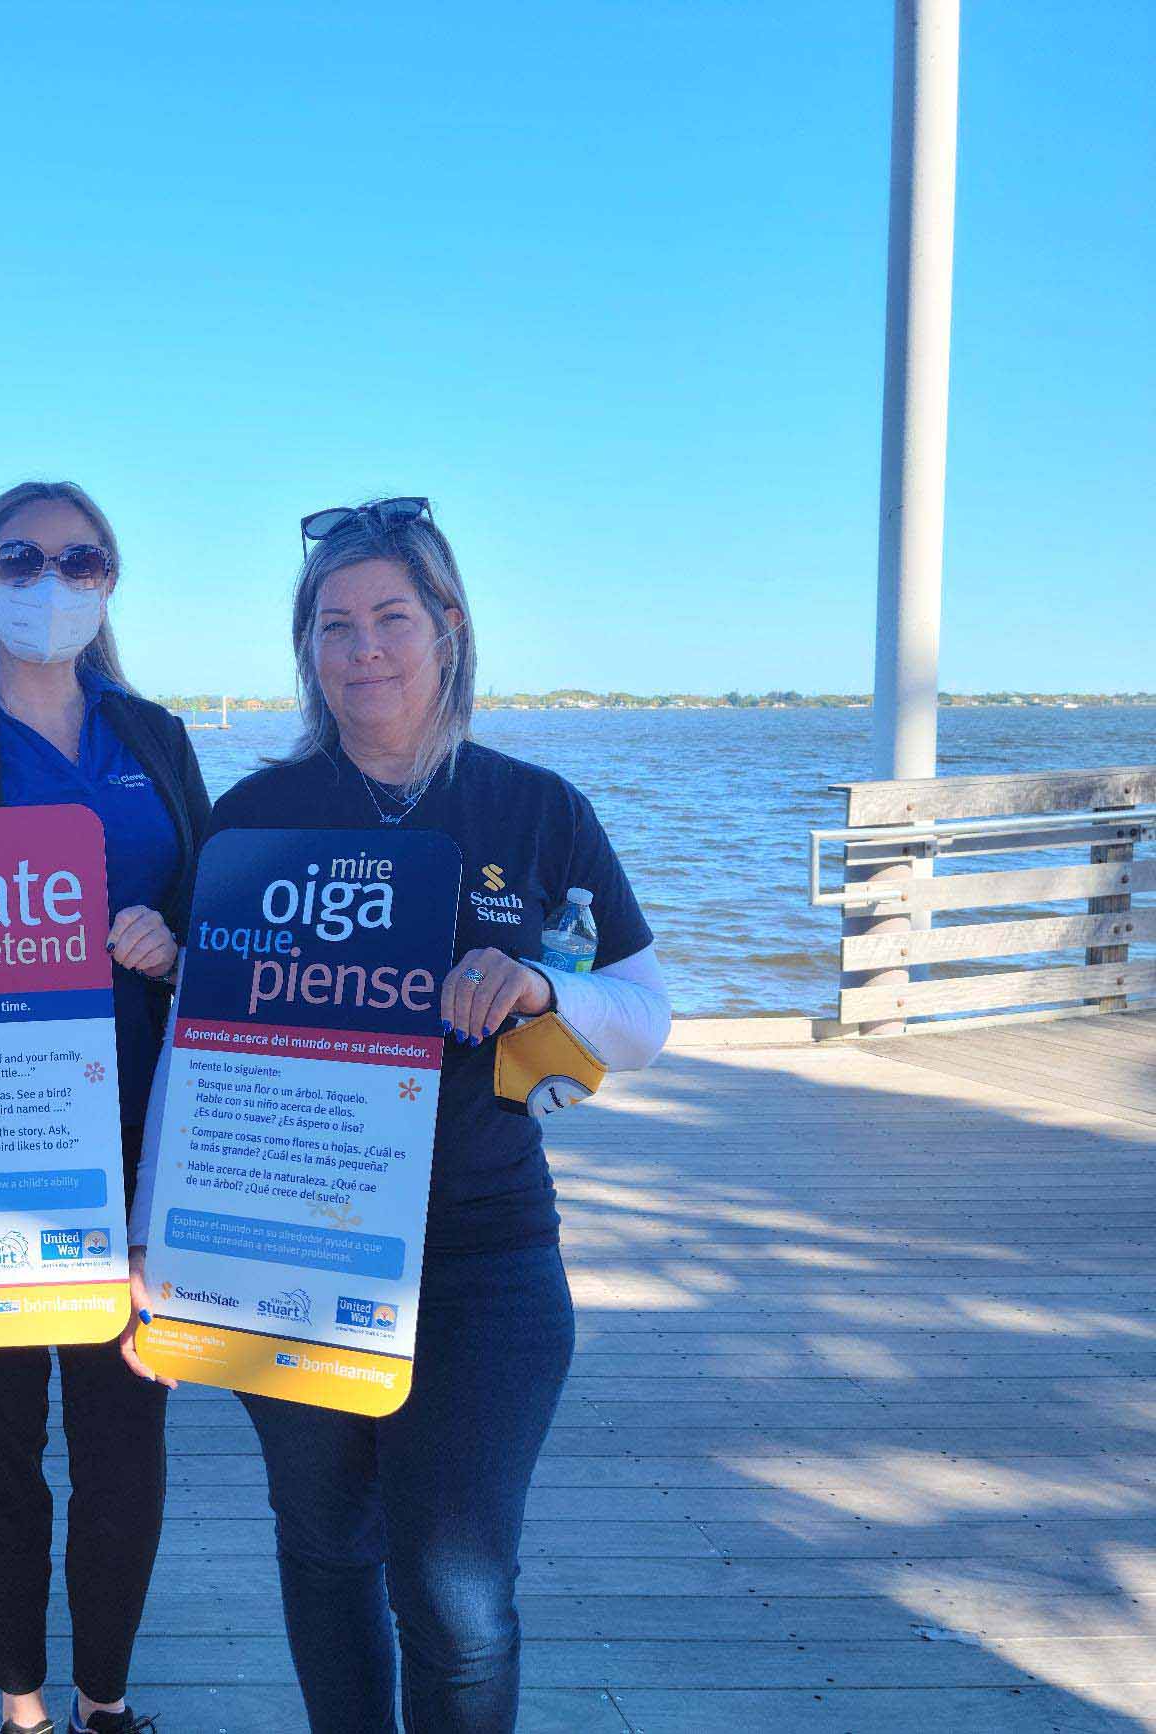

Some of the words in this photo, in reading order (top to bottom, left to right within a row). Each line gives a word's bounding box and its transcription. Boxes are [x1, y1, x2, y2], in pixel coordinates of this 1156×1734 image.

[331, 852, 392, 880] mire
[263, 864, 393, 941] oiga
[470, 892, 523, 908] South
[477, 907, 522, 925] State
[199, 920, 293, 959] toque
[249, 947, 434, 1014] piense
[1, 1001, 30, 1010] time.
[184, 1028, 230, 1040] Aprenda
[232, 1033, 268, 1044] acerca
[271, 1035, 289, 1046] del
[290, 1038, 330, 1048] mundo
[332, 1041, 348, 1051] en
[350, 1042, 366, 1055] su
[368, 1043, 430, 1057] alrededor.
[4, 1053, 23, 1063] and
[25, 1054, 47, 1063] your
[50, 1051, 82, 1061] family.
[190, 1060, 221, 1071] Intente
[224, 1063, 232, 1072] lo
[234, 1064, 282, 1076] siguiente:
[16, 1089, 35, 1099] See
[46, 1087, 71, 1097] bird?
[198, 1079, 232, 1091] Busque
[235, 1084, 251, 1092] una
[254, 1084, 272, 1094] flor
[281, 1089, 292, 1097] un
[295, 1087, 323, 1100] árbol.
[326, 1091, 368, 1104] Tóquelo.
[16, 1103, 50, 1113] named
[196, 1093, 224, 1103] Hable
[225, 1097, 241, 1106] con
[242, 1099, 255, 1107] su
[257, 1099, 278, 1110] niño
[280, 1103, 311, 1112] acerca
[314, 1104, 326, 1113] de
[327, 1106, 354, 1117] ellos.
[211, 1109, 232, 1120] duro
[243, 1114, 276, 1124] suave?
[297, 1117, 329, 1130] áspero
[341, 1121, 364, 1133] liso?
[43, 1233, 79, 1244] United
[58, 1244, 79, 1257] Way
[175, 1287, 239, 1307] SouthState
[257, 1300, 300, 1317] Stuart
[304, 1355, 395, 1388] bornlearning
